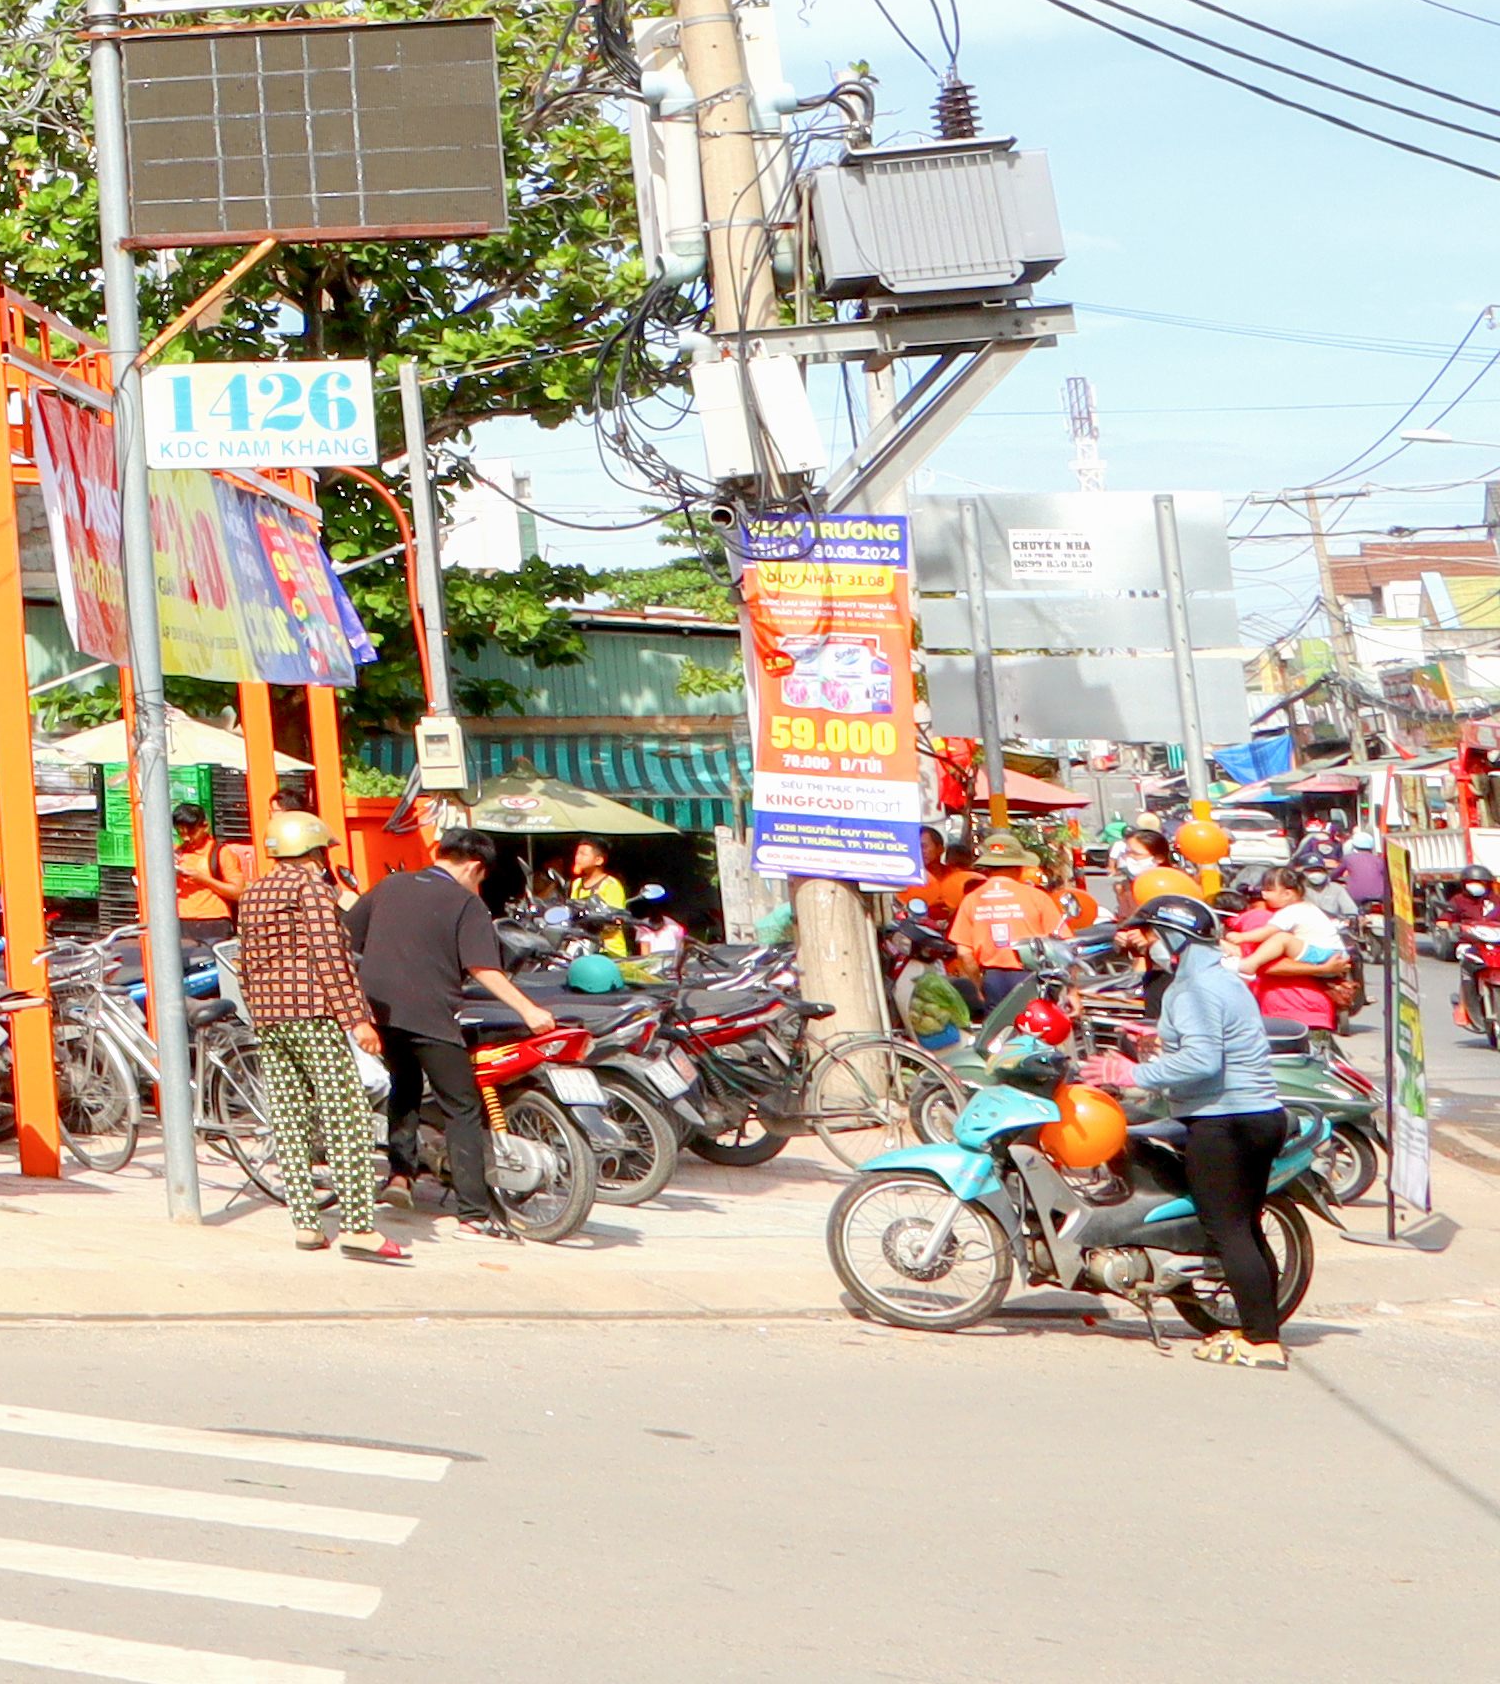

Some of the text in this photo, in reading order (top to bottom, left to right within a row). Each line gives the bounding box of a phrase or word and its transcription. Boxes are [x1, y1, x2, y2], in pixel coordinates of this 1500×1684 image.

[167, 371, 358, 433] 1426
[160, 437, 369, 459] KDC NAM KHANG
[813, 545, 900, 561] 30.08.2024
[767, 573, 797, 585] DUY
[848, 574, 885, 587] 31.08
[771, 715, 897, 756] 59.000
[773, 834, 801, 844] LONG
[840, 828, 862, 838] DUY
